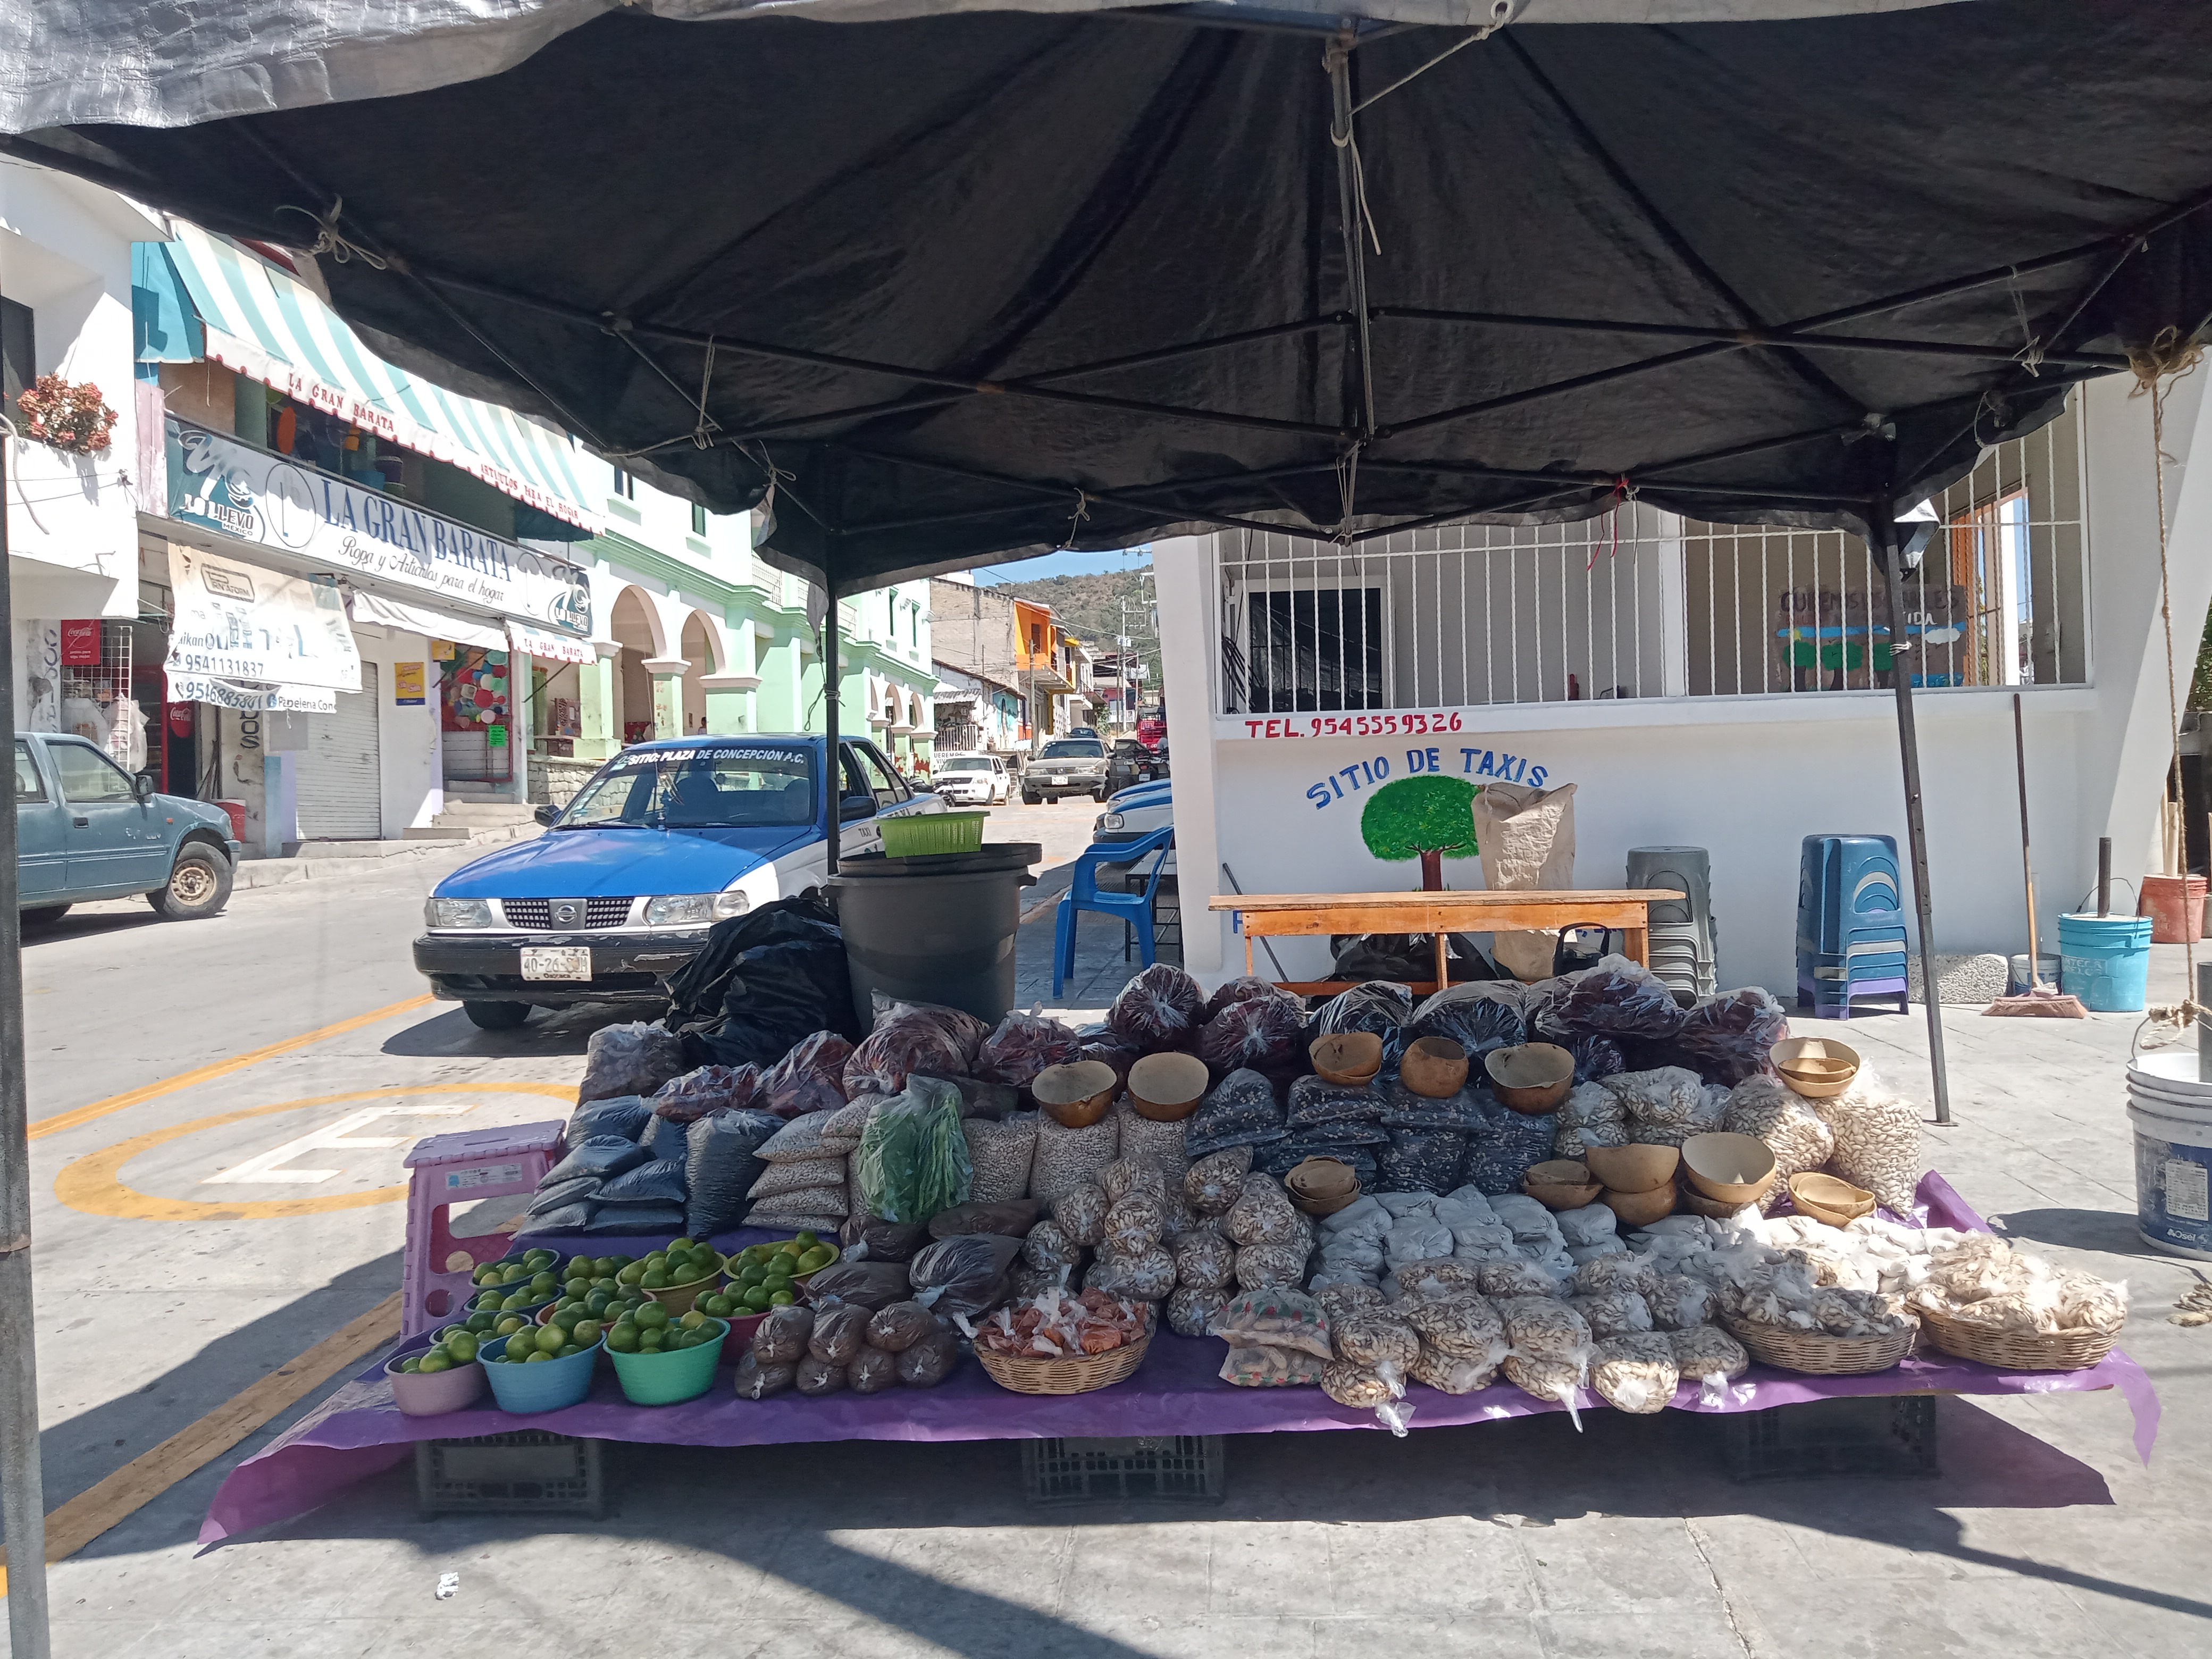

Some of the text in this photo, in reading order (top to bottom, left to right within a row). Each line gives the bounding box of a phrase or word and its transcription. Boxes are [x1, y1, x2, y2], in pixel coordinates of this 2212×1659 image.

[289, 373, 394, 432] LA GRAN BARATA
[321, 479, 512, 582] LA GRAN BARATA
[338, 536, 374, 571] Ropa
[374, 555, 387, 572] y
[468, 582, 476, 592] el
[524, 638, 583, 658] LA GRAN BARATA
[186, 653, 264, 677] 9541131837
[1245, 718, 1305, 739] TEL.
[660, 750, 697, 761] PLAZA
[697, 750, 712, 760] DE
[783, 751, 805, 764] A.C.
[1306, 748, 1548, 810] SITIO DE TAXIS
[858, 827, 872, 837] TAXI
